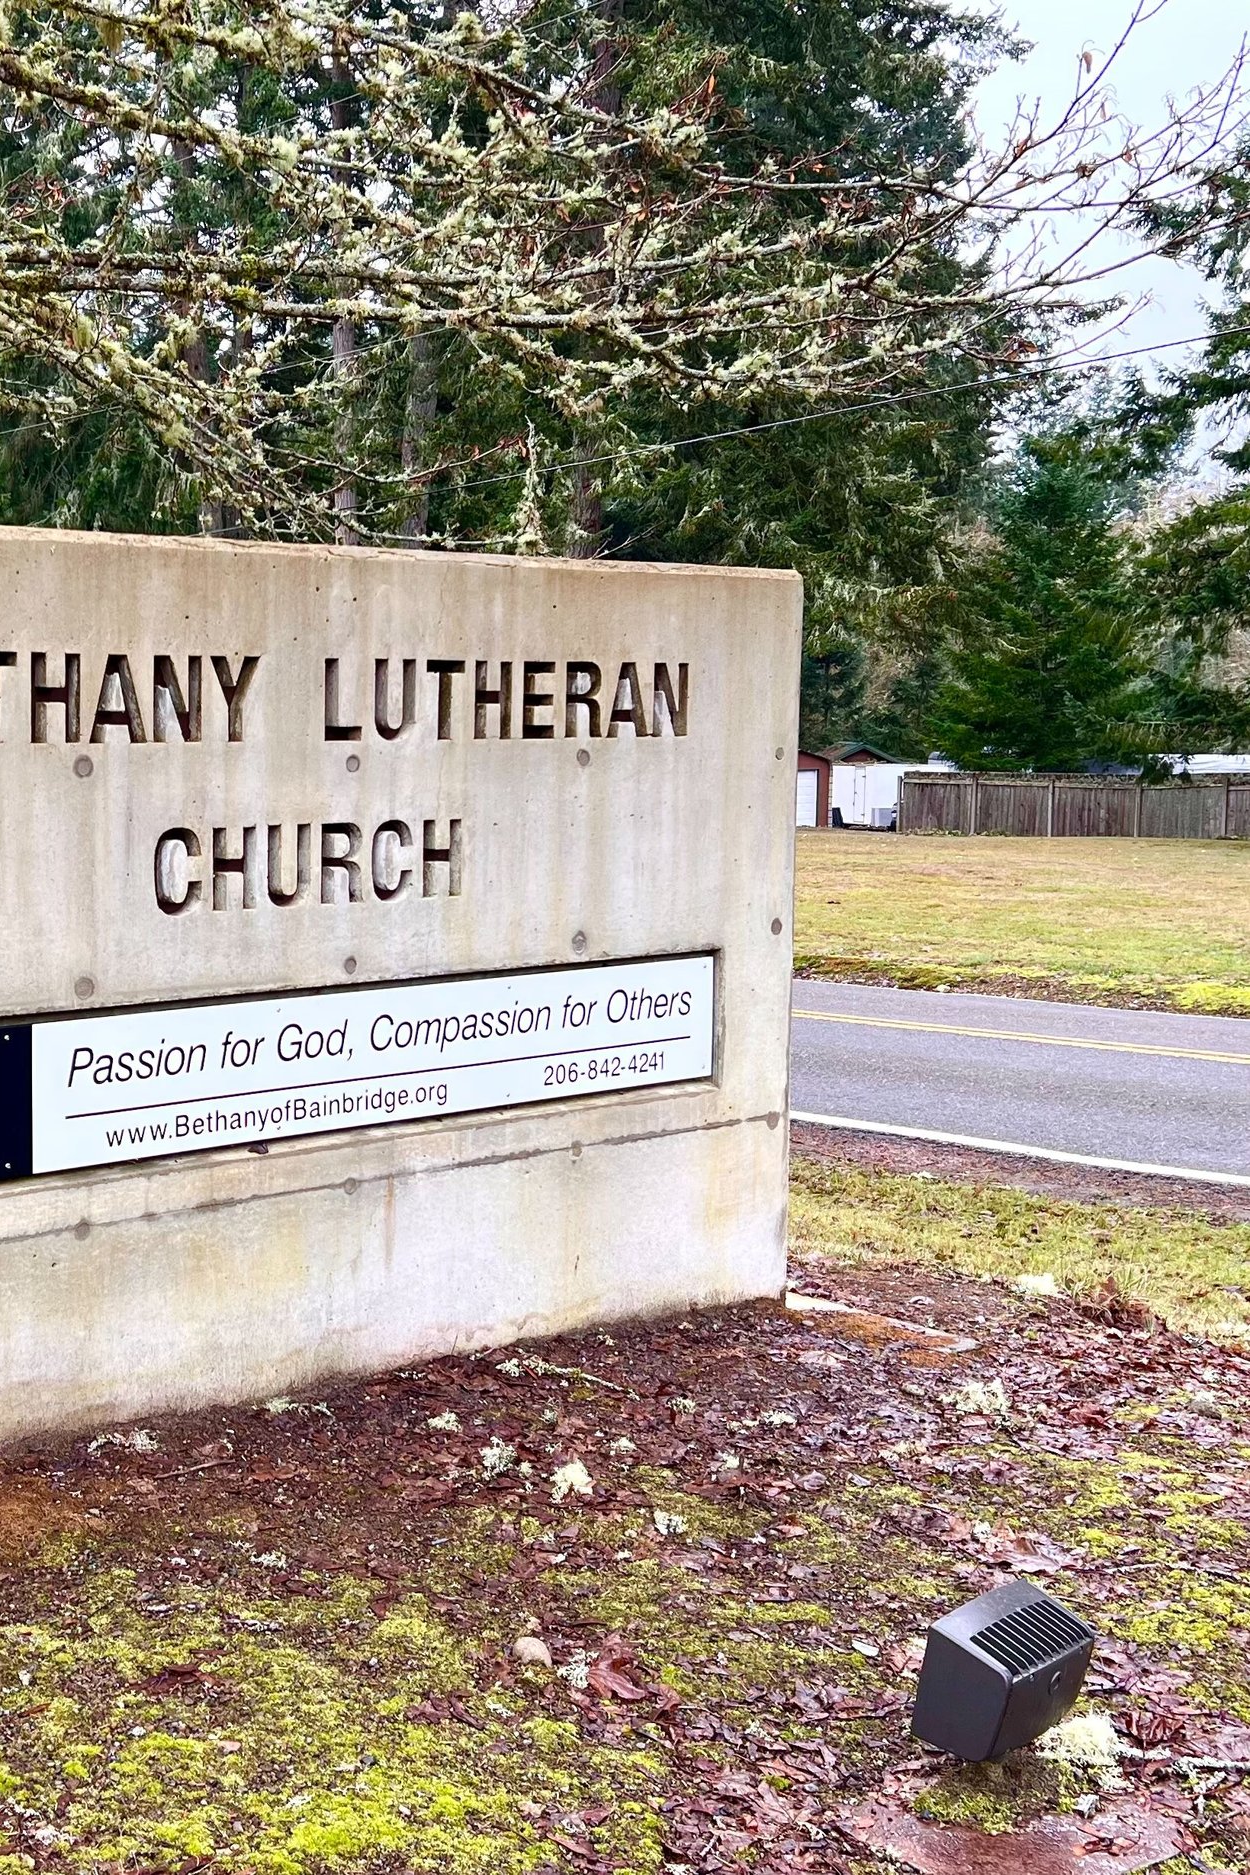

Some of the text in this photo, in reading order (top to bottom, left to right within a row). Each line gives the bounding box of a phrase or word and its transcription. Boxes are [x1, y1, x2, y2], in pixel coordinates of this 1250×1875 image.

[323, 657, 690, 742] LUTHERAN
[153, 818, 463, 916] CHURCH
[67, 987, 692, 1088] Passion for God, Compassion for Others
[543, 1051, 665, 1086] 206-842-4241
[106, 1083, 448, 1148] www.BethanyofBainbridge.org
